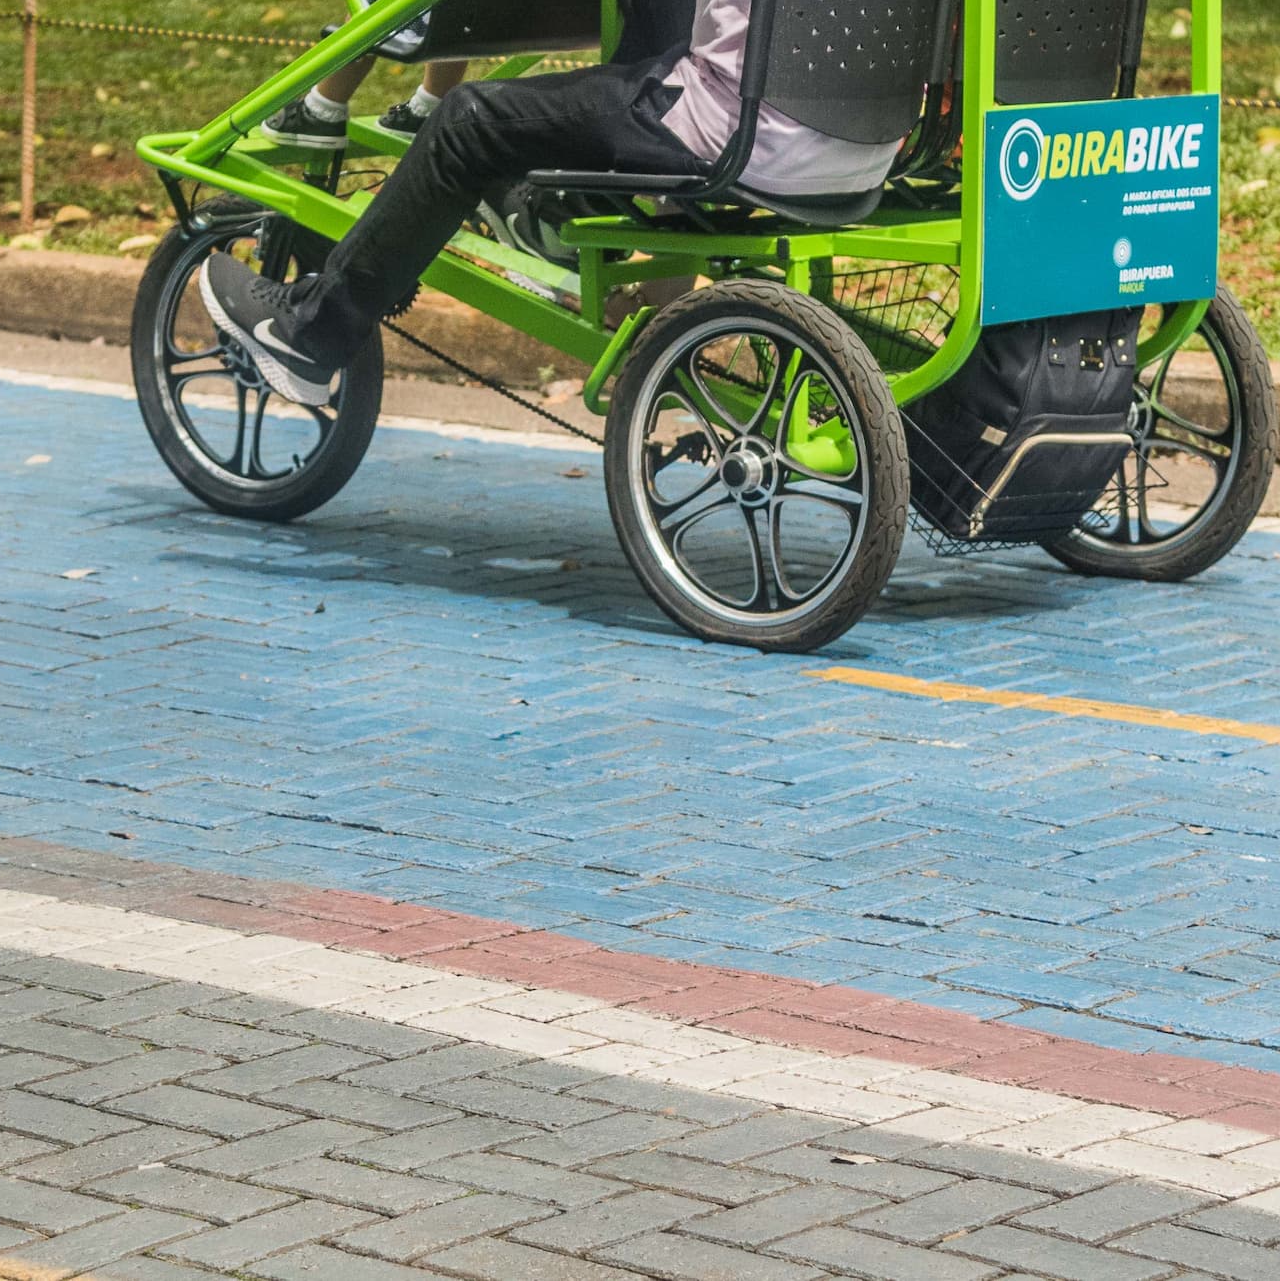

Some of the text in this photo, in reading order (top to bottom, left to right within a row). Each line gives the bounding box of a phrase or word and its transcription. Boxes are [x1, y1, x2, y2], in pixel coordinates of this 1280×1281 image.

[1039, 123, 1204, 180] IBIRABIKE
[1123, 192, 1129, 201] A
[1129, 191, 1152, 202] MARCA
[1176, 187, 1189, 198] DOS
[1123, 206, 1132, 215] DO
[1132, 203, 1158, 215] PARQUE
[1120, 265, 1173, 282] IBIRAPUERA
[1120, 282, 1144, 293] PARQUE
